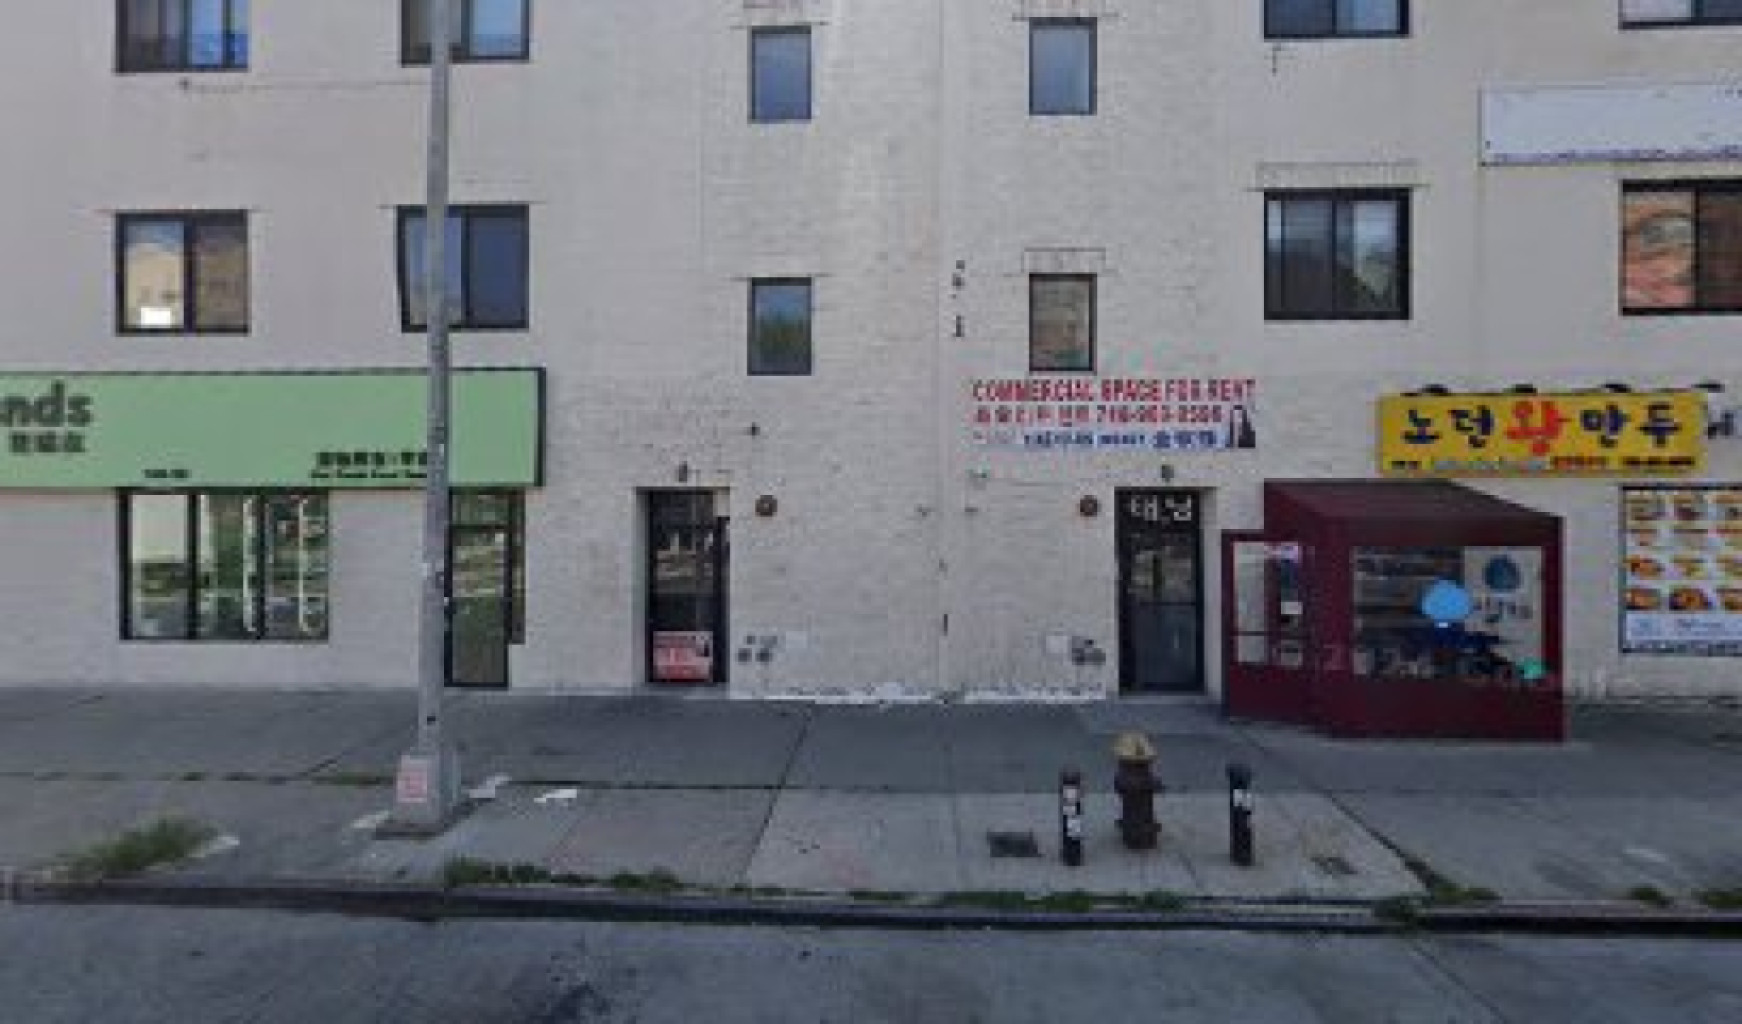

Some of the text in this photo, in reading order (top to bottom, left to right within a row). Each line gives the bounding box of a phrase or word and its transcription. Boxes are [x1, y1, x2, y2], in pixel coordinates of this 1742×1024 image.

[973, 379, 1256, 402] COMMERCIAL SPACE FOR RENT
